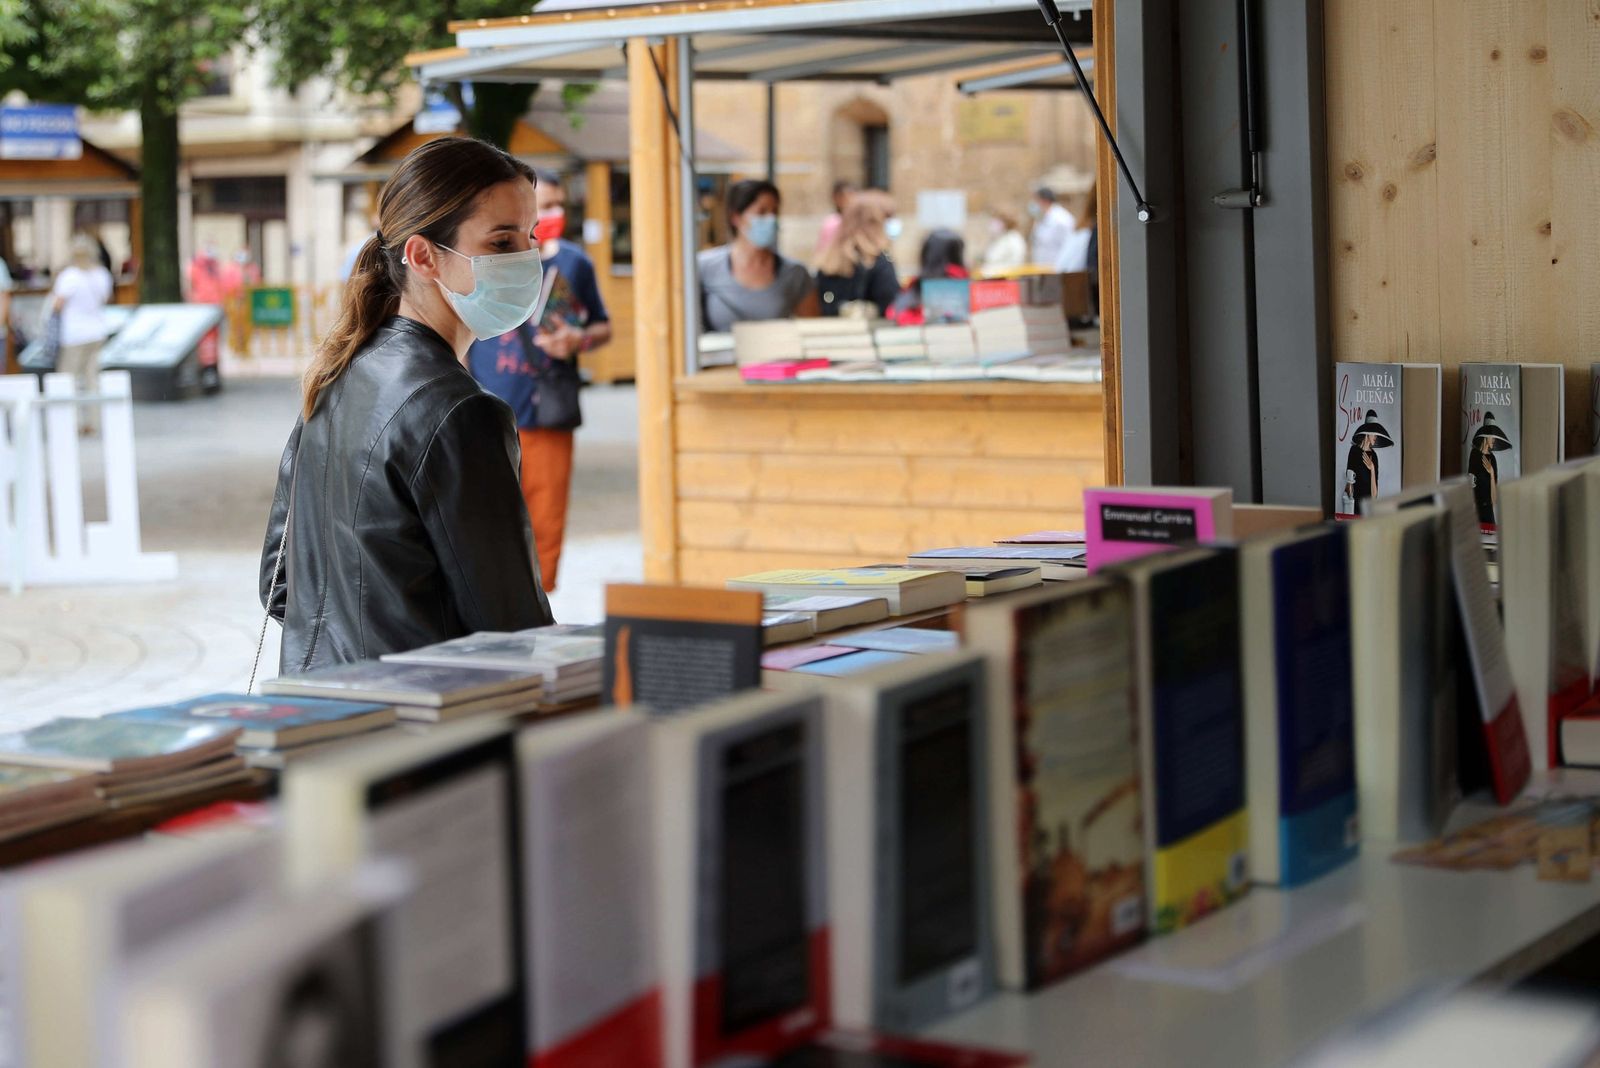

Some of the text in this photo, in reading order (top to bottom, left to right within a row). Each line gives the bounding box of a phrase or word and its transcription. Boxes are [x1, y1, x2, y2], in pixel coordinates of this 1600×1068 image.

[1362, 371, 1394, 388] MARÍA
[1480, 372, 1511, 389] MARÍA
[1356, 388, 1394, 405] DUEÑAS
[1474, 389, 1511, 406] DUEÑAS
[1338, 373, 1363, 442] Sira
[1461, 371, 1482, 445] Sira
[1103, 508, 1152, 523] Emmanuel
